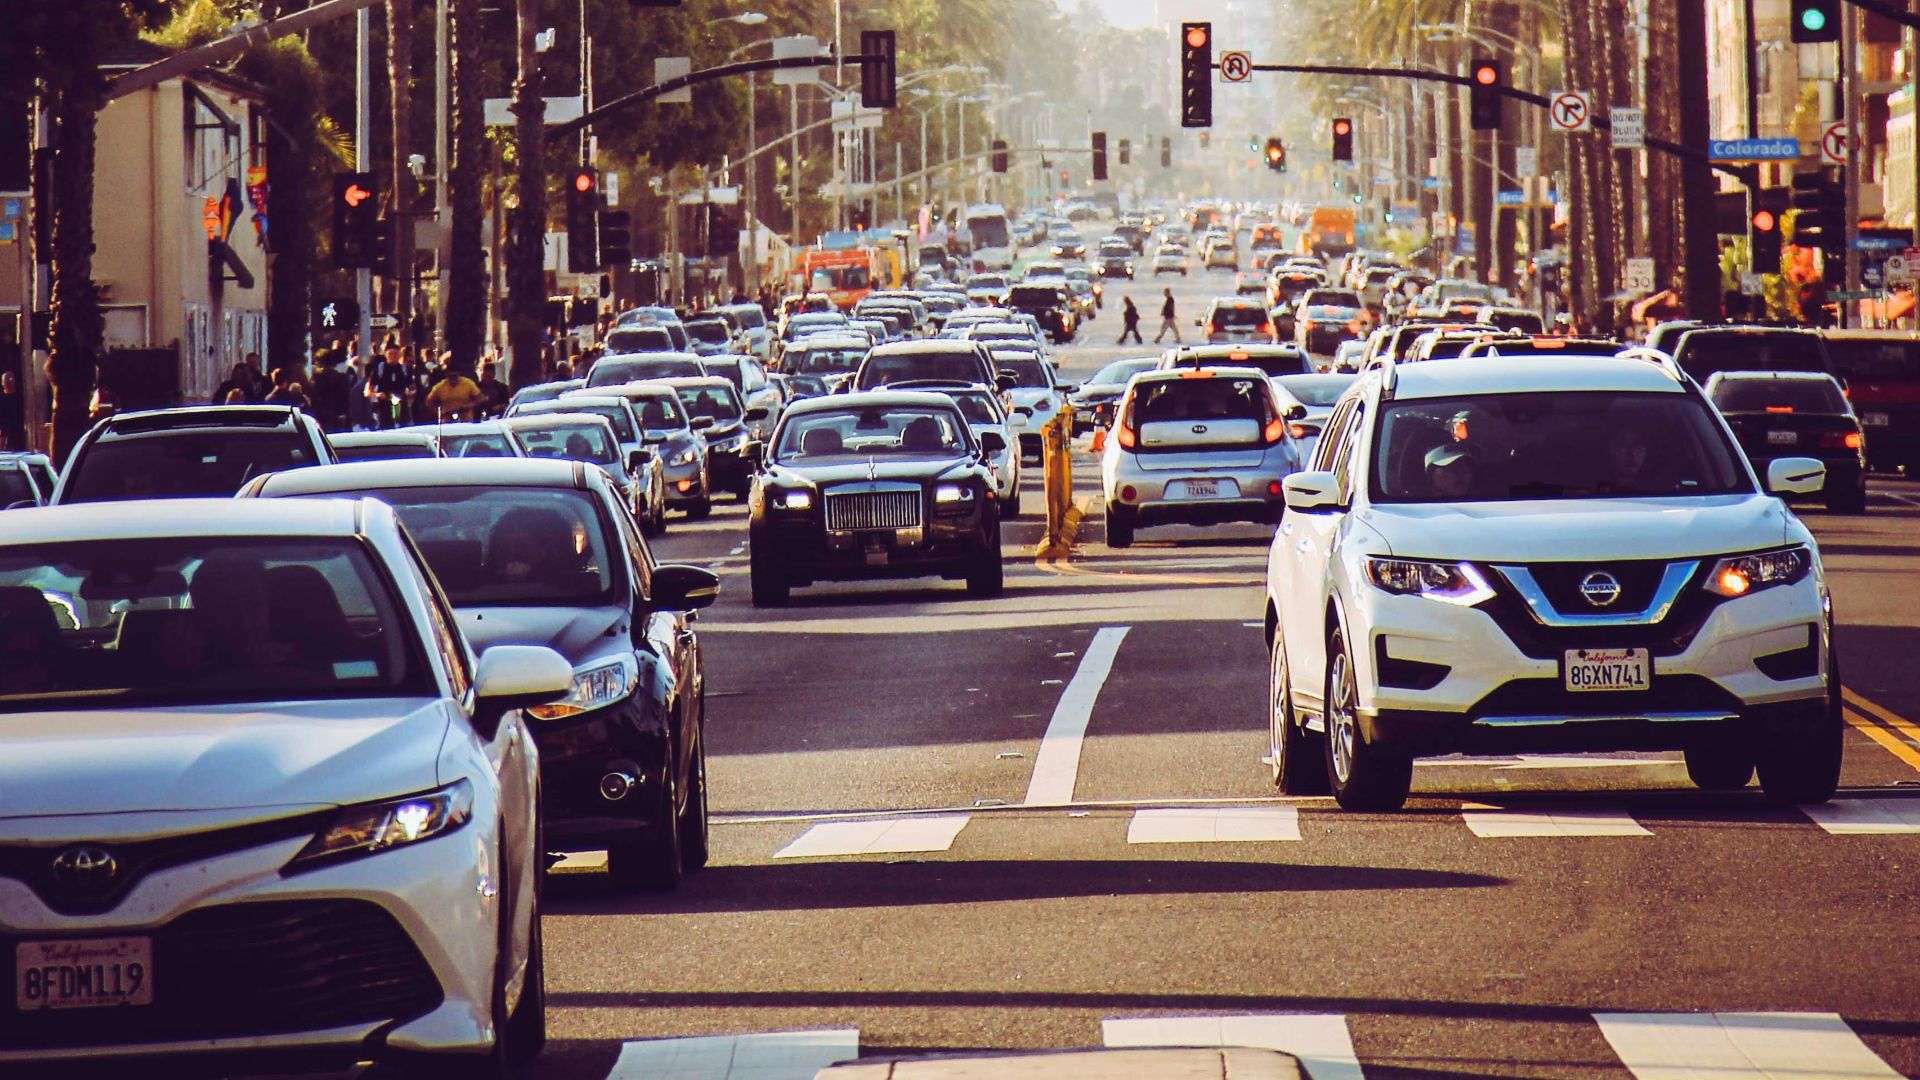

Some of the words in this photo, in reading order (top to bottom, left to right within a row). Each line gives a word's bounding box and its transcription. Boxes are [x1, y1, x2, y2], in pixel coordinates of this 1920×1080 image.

[1713, 141, 1793, 155] Colorado
[1630, 276, 1650, 288] 30
[1581, 584, 1619, 592] NISSAN
[1582, 651, 1628, 664] California
[1571, 664, 1644, 685] 8GXN741
[25, 962, 144, 999] 8FDM119
